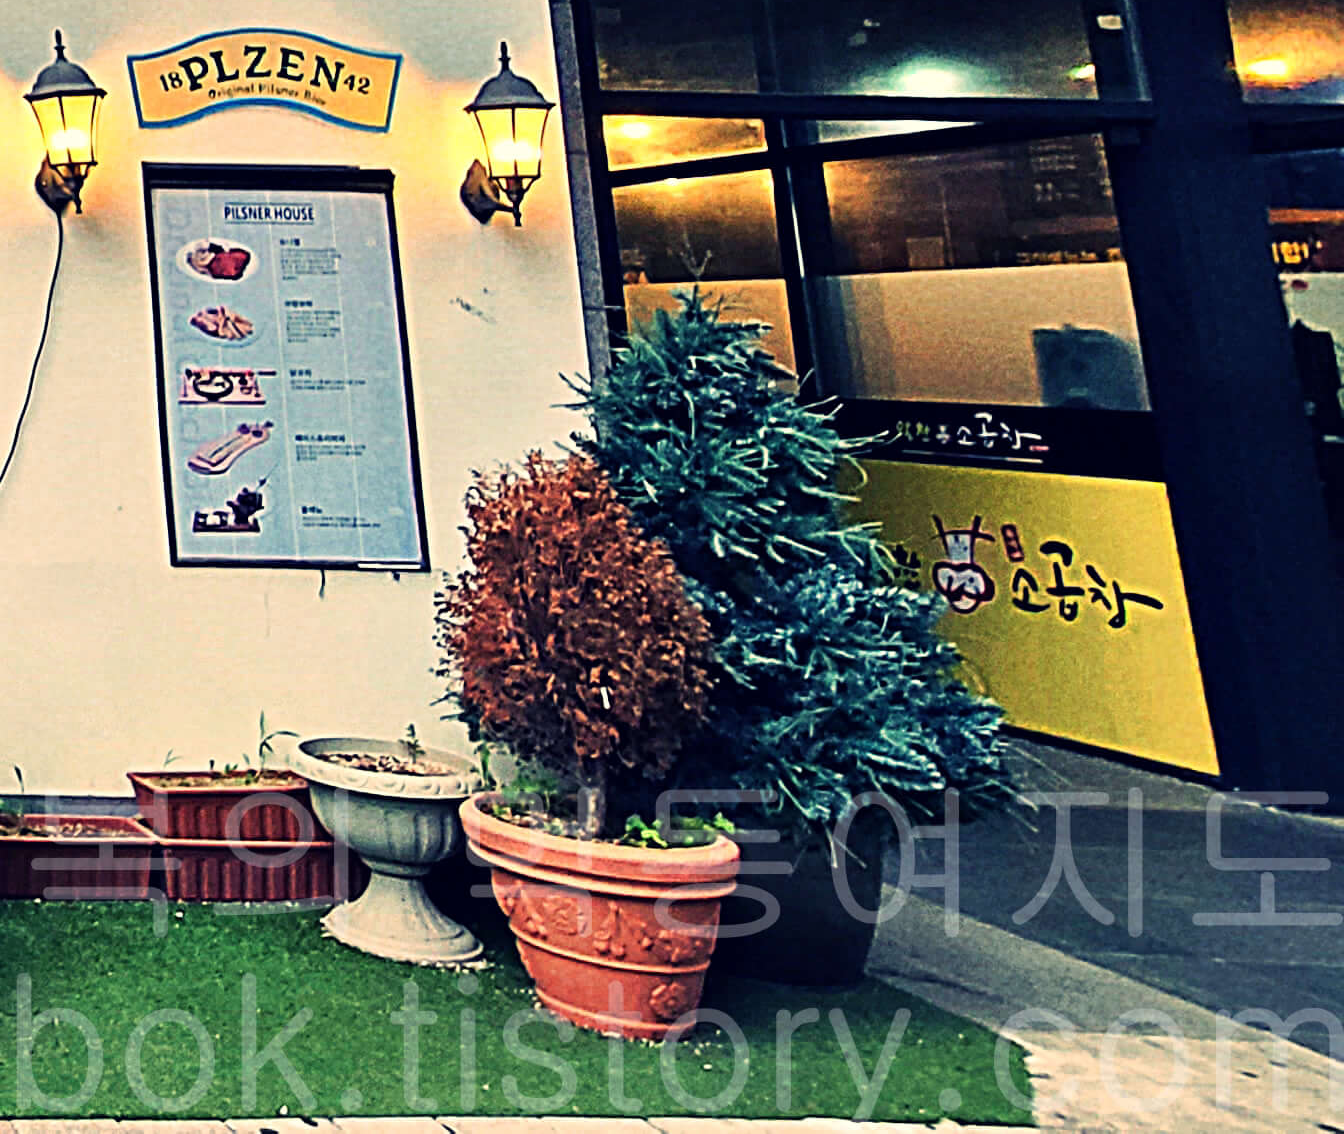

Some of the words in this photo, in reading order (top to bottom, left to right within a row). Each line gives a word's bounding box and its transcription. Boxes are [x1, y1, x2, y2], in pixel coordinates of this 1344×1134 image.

[159, 71, 183, 92] 18
[178, 45, 346, 92] PLZEN
[343, 74, 371, 95] 42
[224, 207, 271, 220] PILSNER
[274, 207, 314, 221] HOUSE
